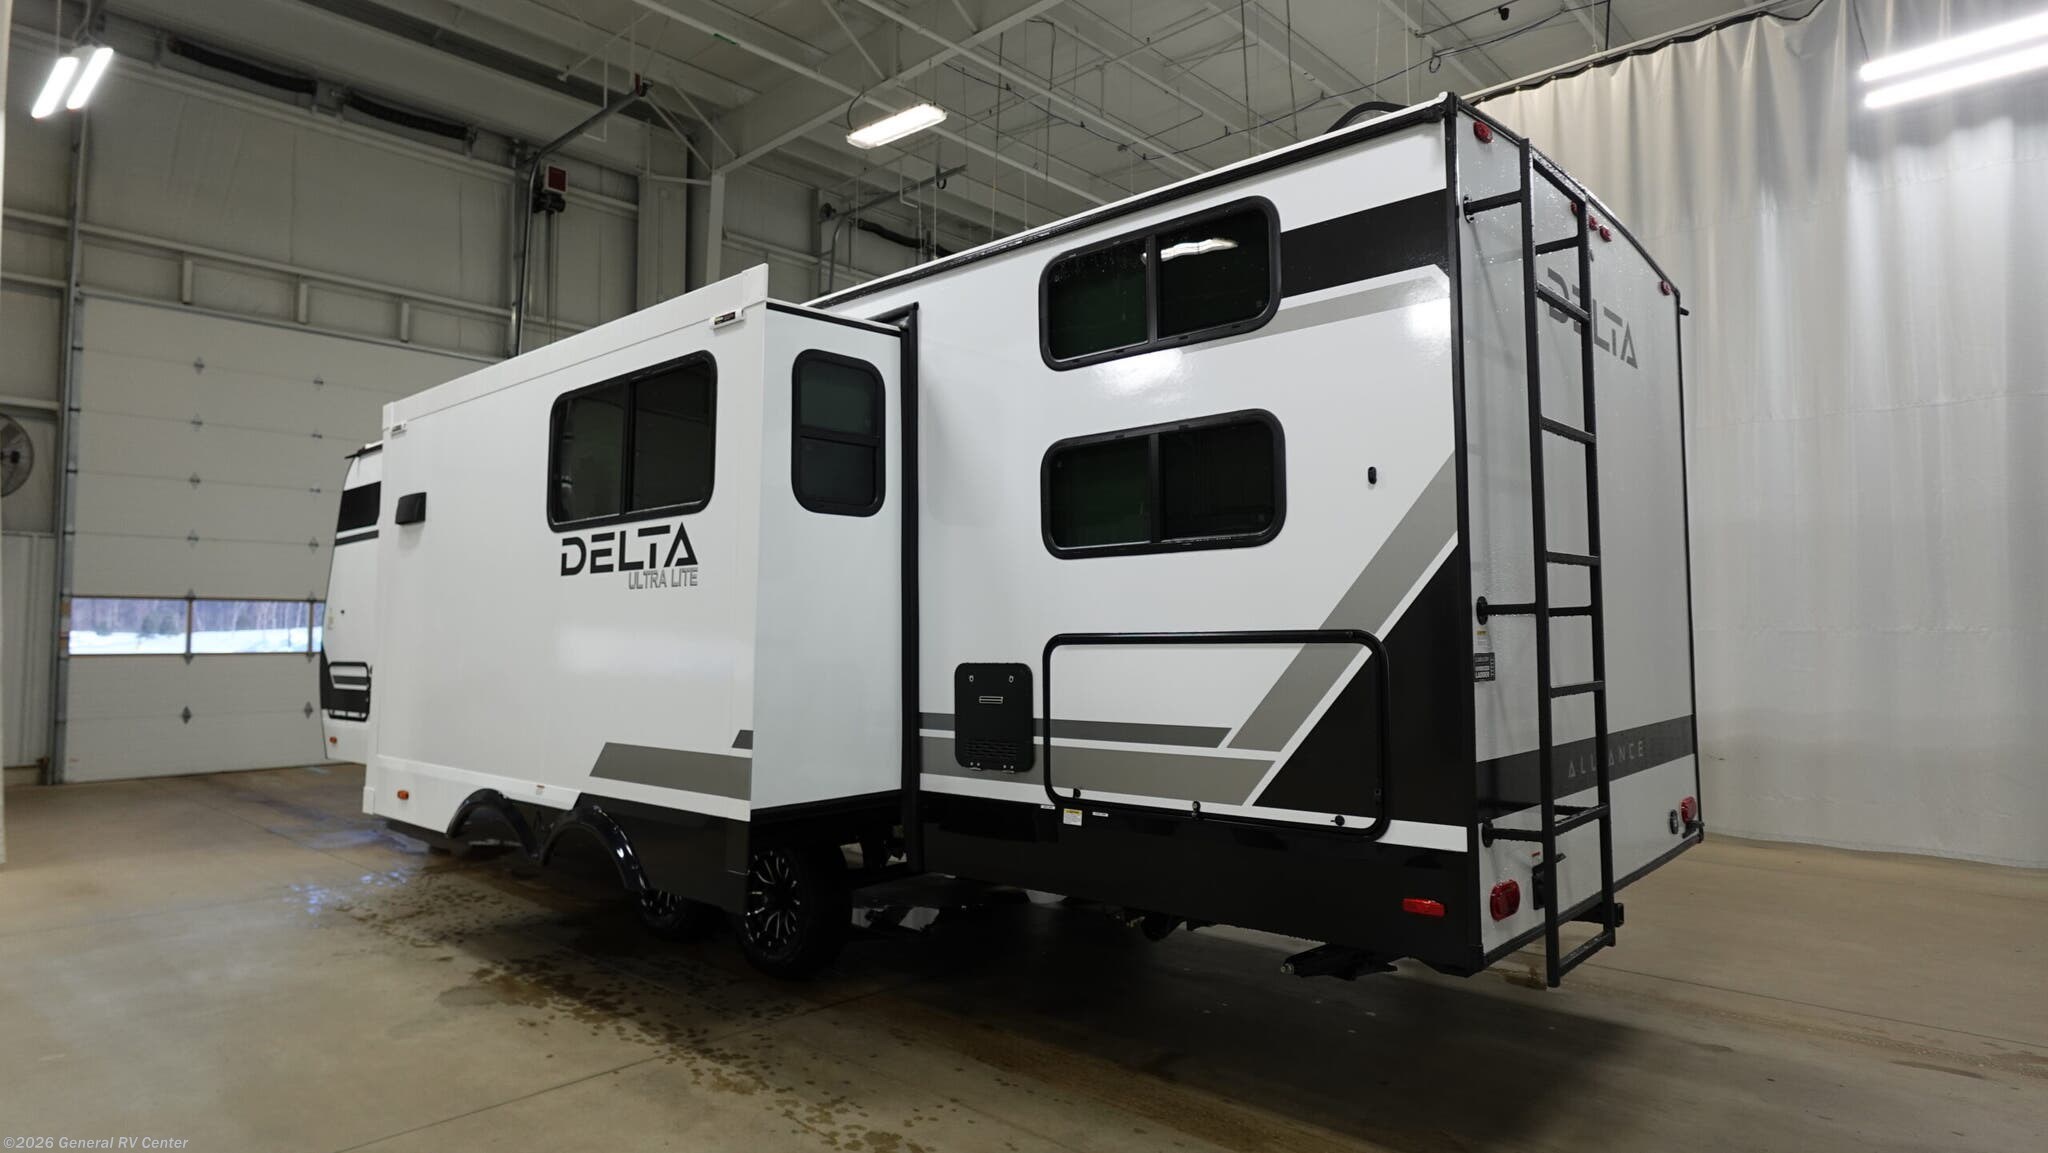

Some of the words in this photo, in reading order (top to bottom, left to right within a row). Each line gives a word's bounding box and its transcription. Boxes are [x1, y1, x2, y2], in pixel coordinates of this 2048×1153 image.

[561, 521, 698, 577] DELTA
[628, 570, 668, 590] ULTRA
[671, 568, 698, 588] LITE
[1568, 740, 1644, 778] ALLANCE
